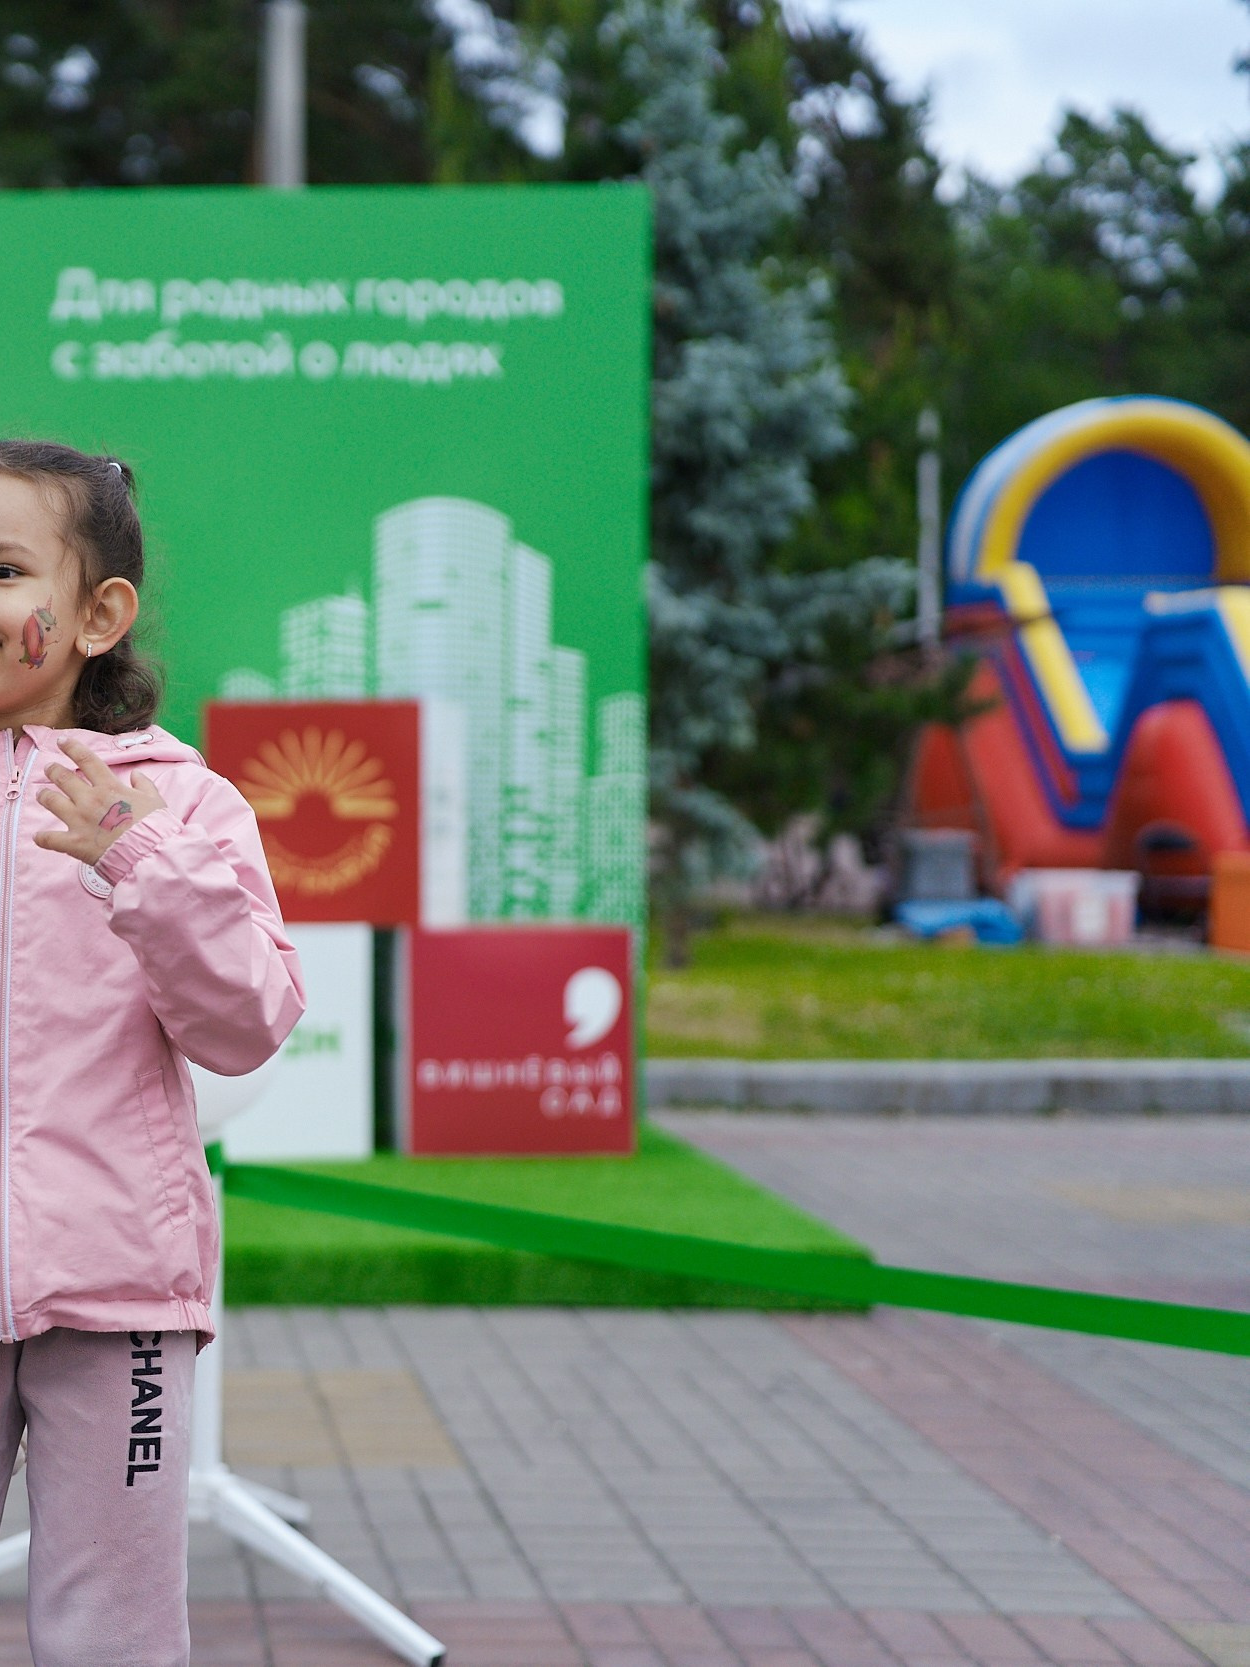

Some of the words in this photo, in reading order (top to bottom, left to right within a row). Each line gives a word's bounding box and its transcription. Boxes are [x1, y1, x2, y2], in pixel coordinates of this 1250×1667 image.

[51, 267, 155, 321] Для
[161, 279, 347, 324] родных
[355, 279, 563, 325] городов
[53, 341, 83, 379] с
[91, 331, 294, 379] заботой
[299, 341, 338, 379] о
[342, 341, 503, 384] людях
[126, 1331, 163, 1487] CHANEL
